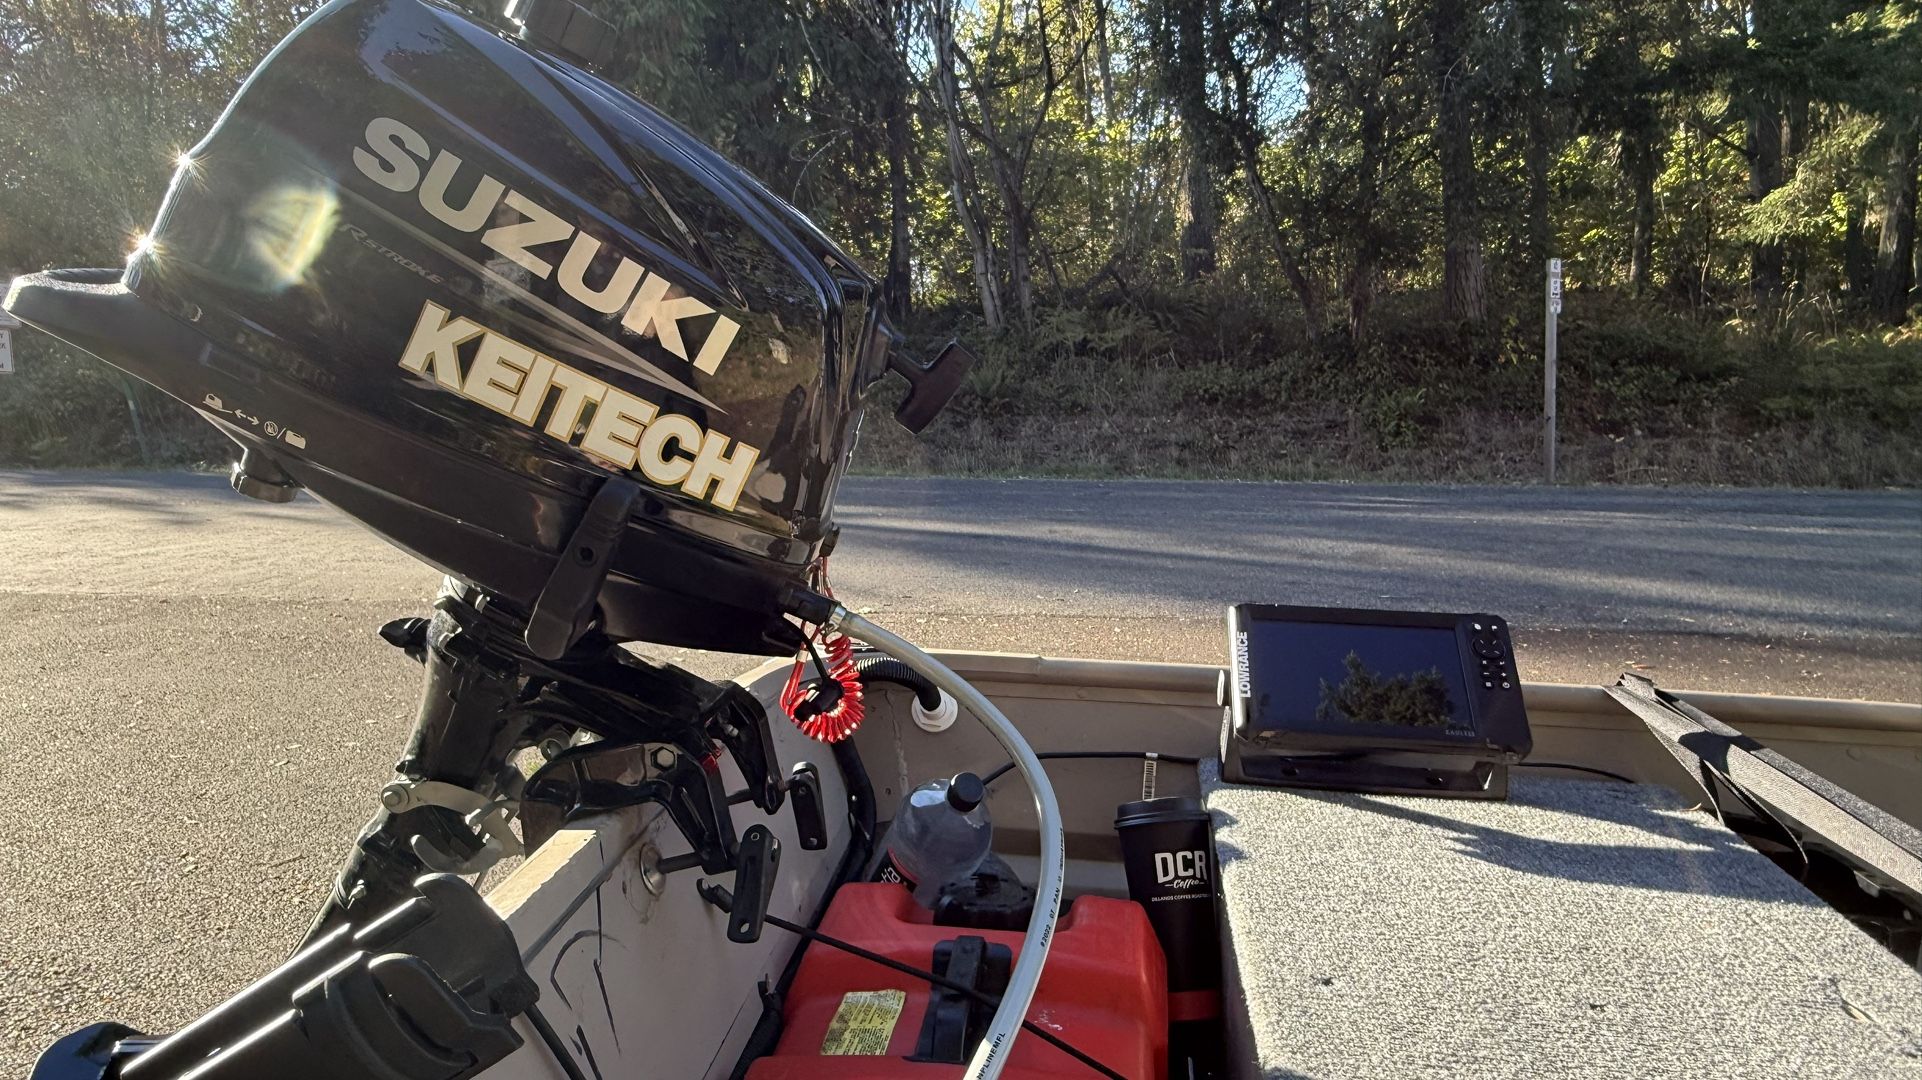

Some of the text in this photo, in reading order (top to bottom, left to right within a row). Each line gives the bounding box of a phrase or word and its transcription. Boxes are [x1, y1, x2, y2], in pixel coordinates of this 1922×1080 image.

[353, 117, 741, 376] SUZUKI
[398, 299, 760, 511] KEITECH
[1237, 631, 1251, 698] LOWRANCE
[1154, 850, 1207, 884] DCR
[1173, 879, 1199, 889] Coffee
